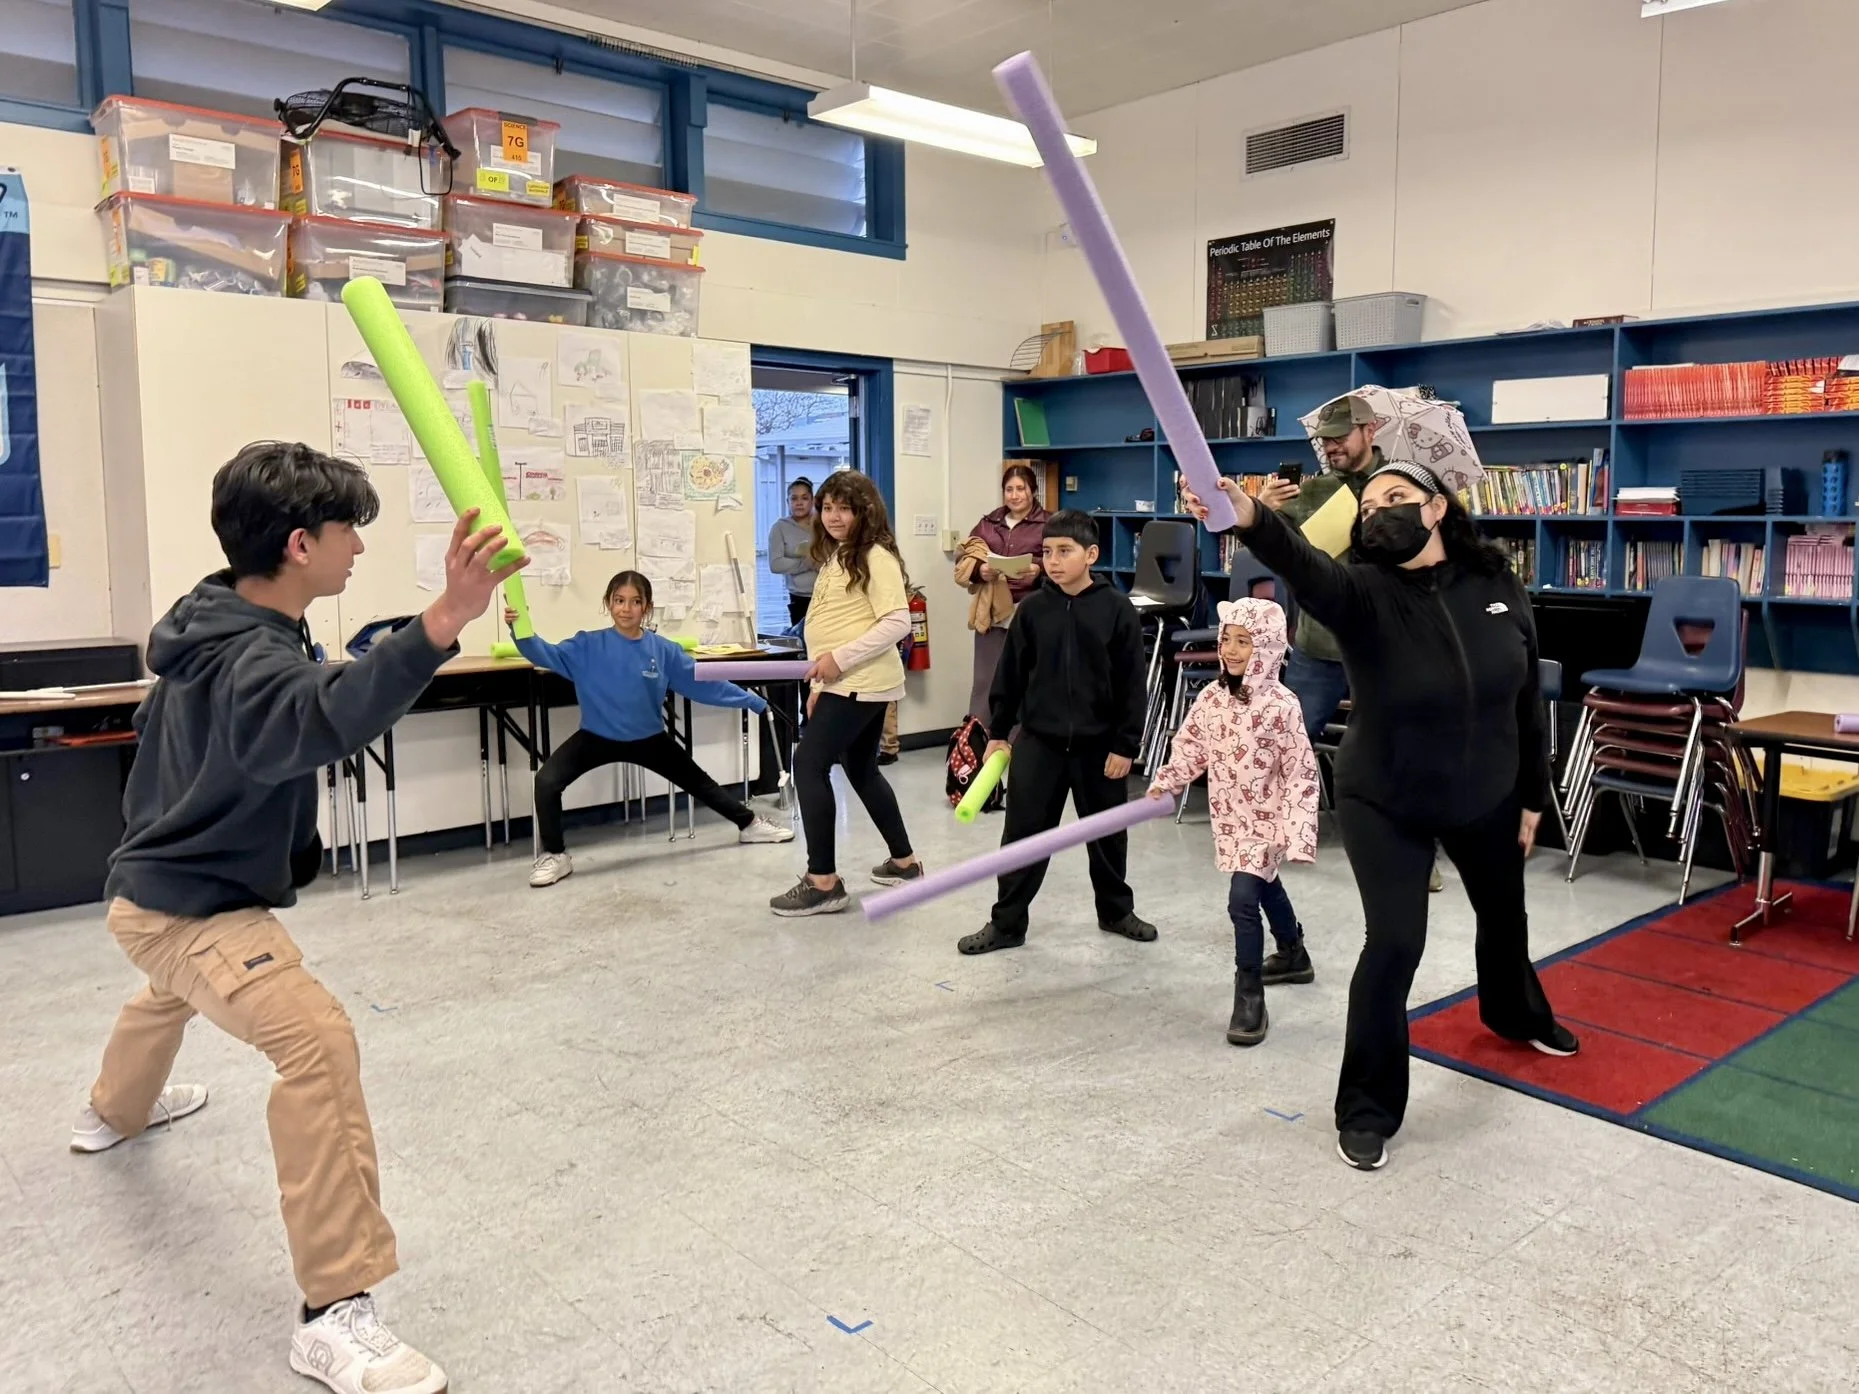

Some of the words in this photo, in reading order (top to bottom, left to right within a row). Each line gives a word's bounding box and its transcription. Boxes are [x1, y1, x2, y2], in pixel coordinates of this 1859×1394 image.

[507, 135, 524, 148] 7G
[4, 211, 18, 219] TM
[1209, 244, 1239, 257] Periodic
[1241, 241, 1261, 252] Table
[1263, 237, 1274, 248] Of
[1275, 235, 1291, 246] The
[1292, 228, 1331, 243] Elements
